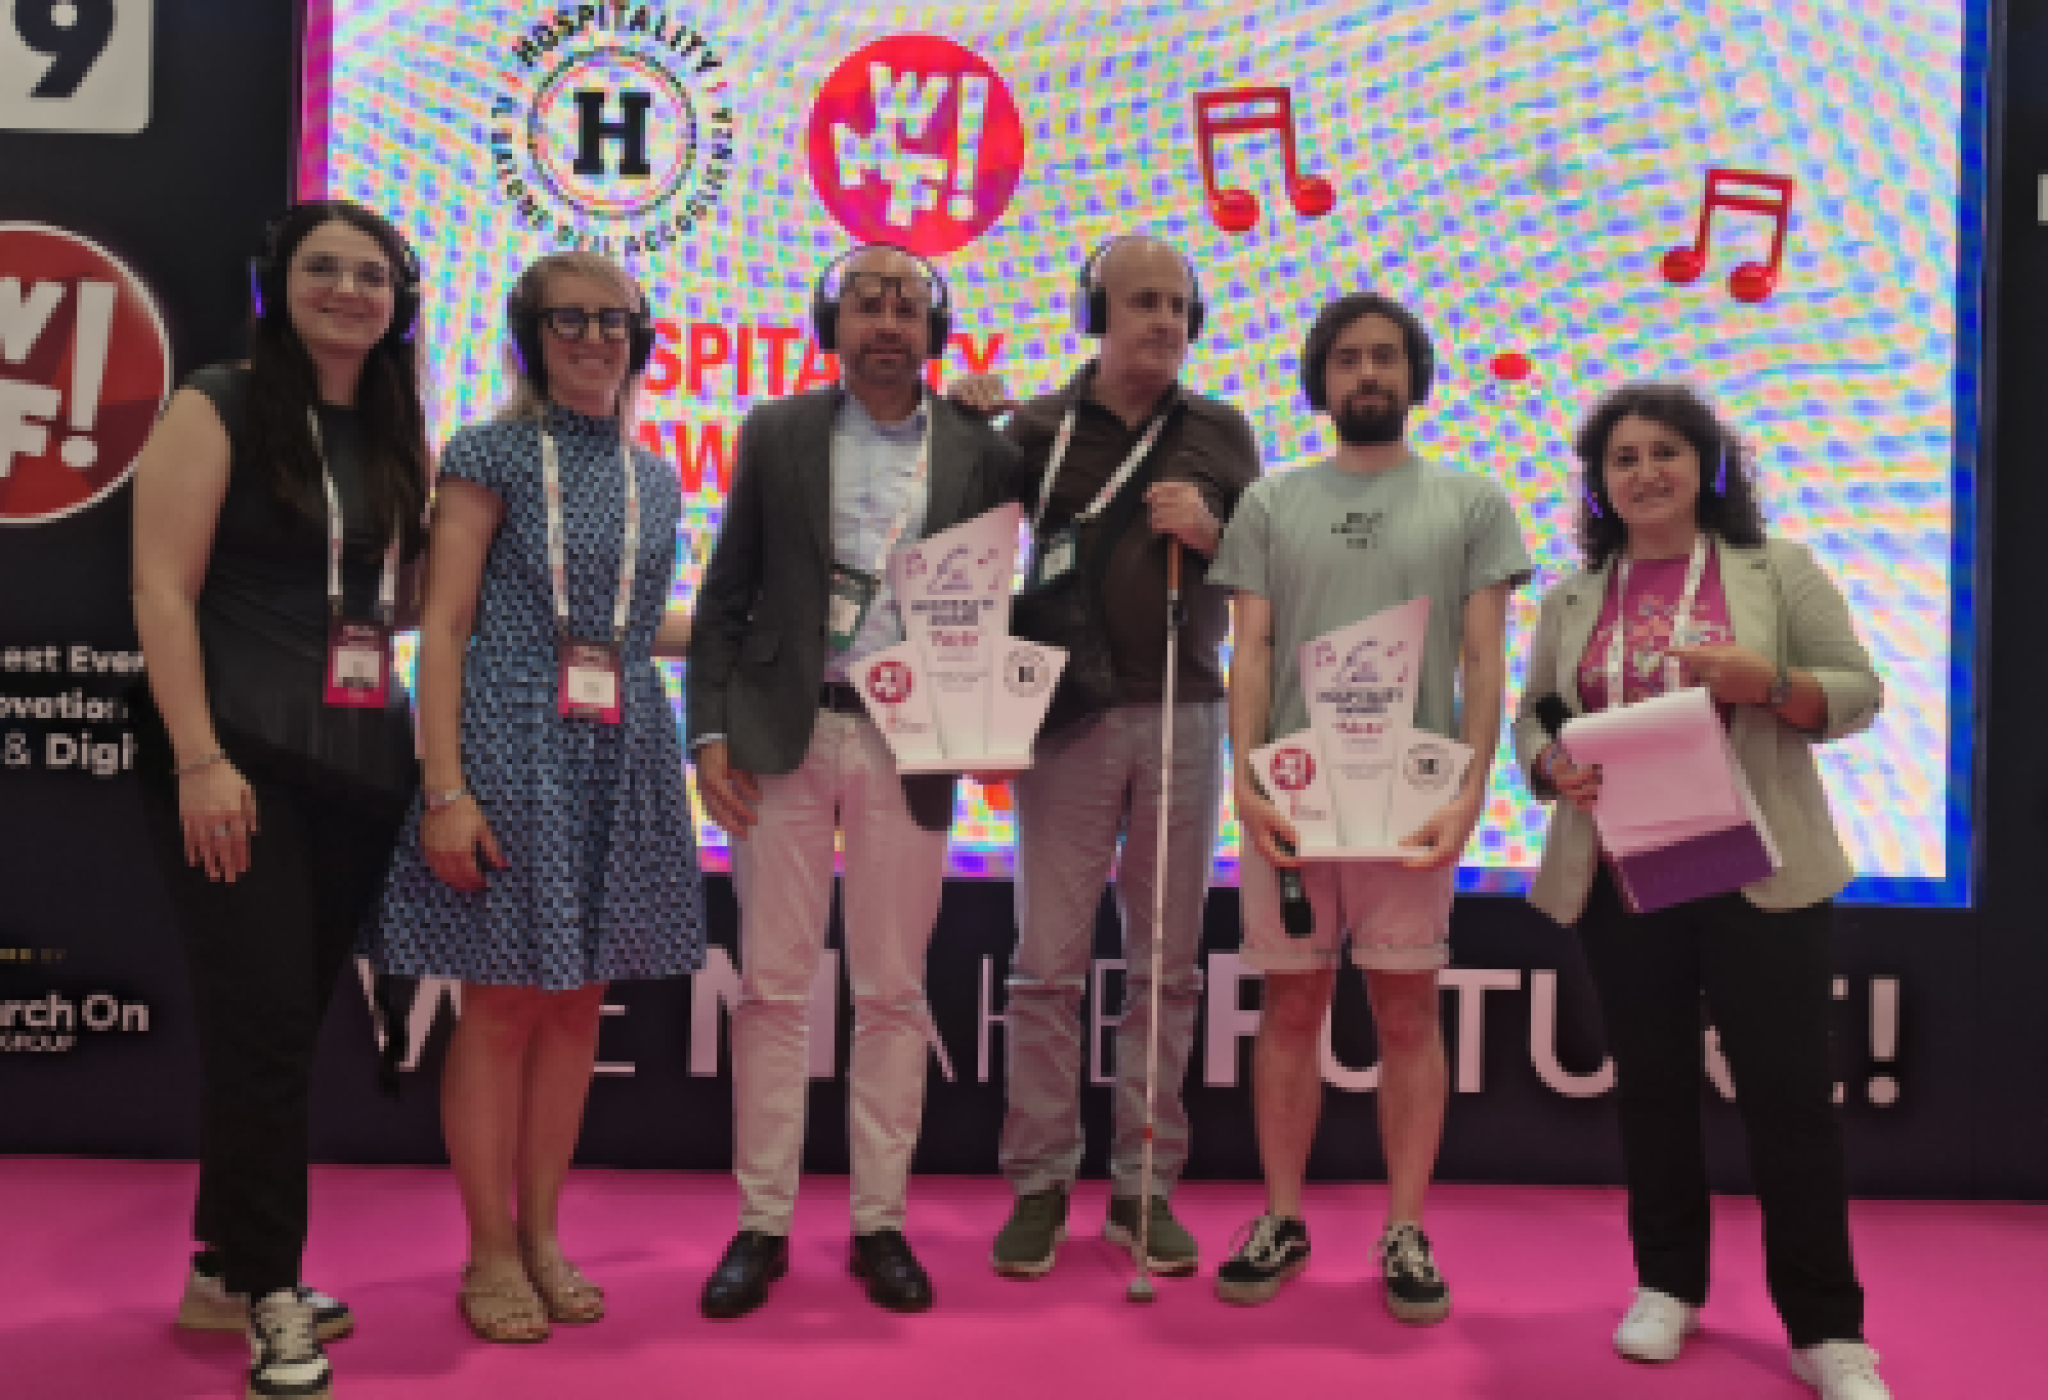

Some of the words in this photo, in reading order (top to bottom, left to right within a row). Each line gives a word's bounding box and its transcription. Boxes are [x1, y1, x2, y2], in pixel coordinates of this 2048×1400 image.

[512, 0, 722, 74] HOSPITALITY
[573, 91, 652, 177] H
[0, 645, 60, 674] est
[46, 731, 136, 777] Digi
[0, 990, 77, 1029] rch
[81, 991, 149, 1031] On
